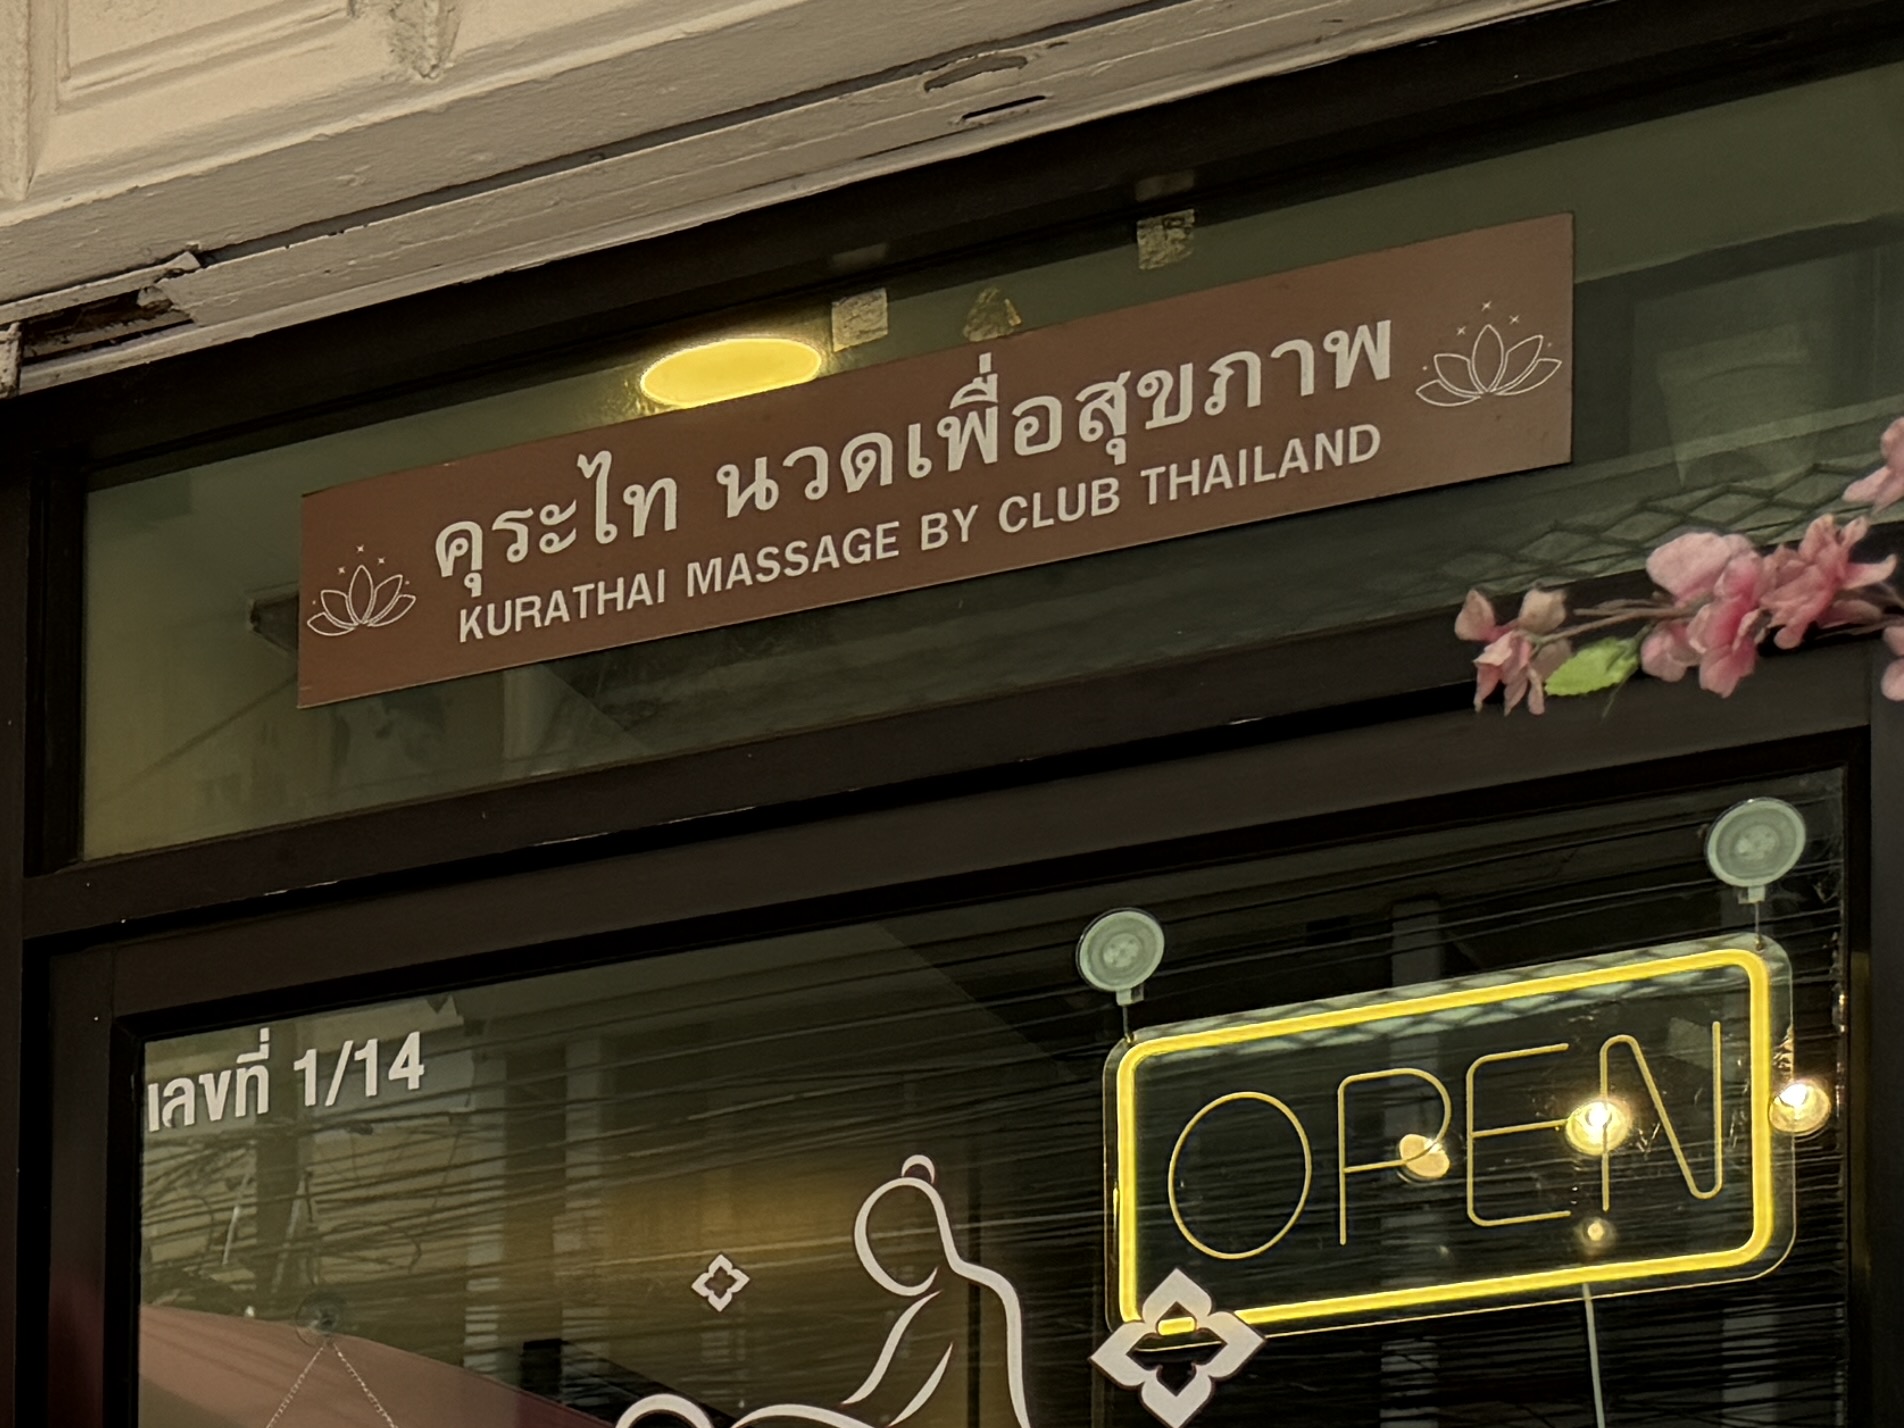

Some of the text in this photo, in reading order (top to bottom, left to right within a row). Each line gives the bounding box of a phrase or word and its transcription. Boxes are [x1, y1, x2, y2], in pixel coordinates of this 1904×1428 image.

[435, 319, 1392, 597] คุระไท นวดเพื่อสุขภาพ
[458, 424, 1381, 643] KURATHAI MASSAGE BY CLUB THAILAND
[148, 1027, 424, 1132] เลขที่ 1/14
[1168, 1019, 1722, 1260] OPEN
